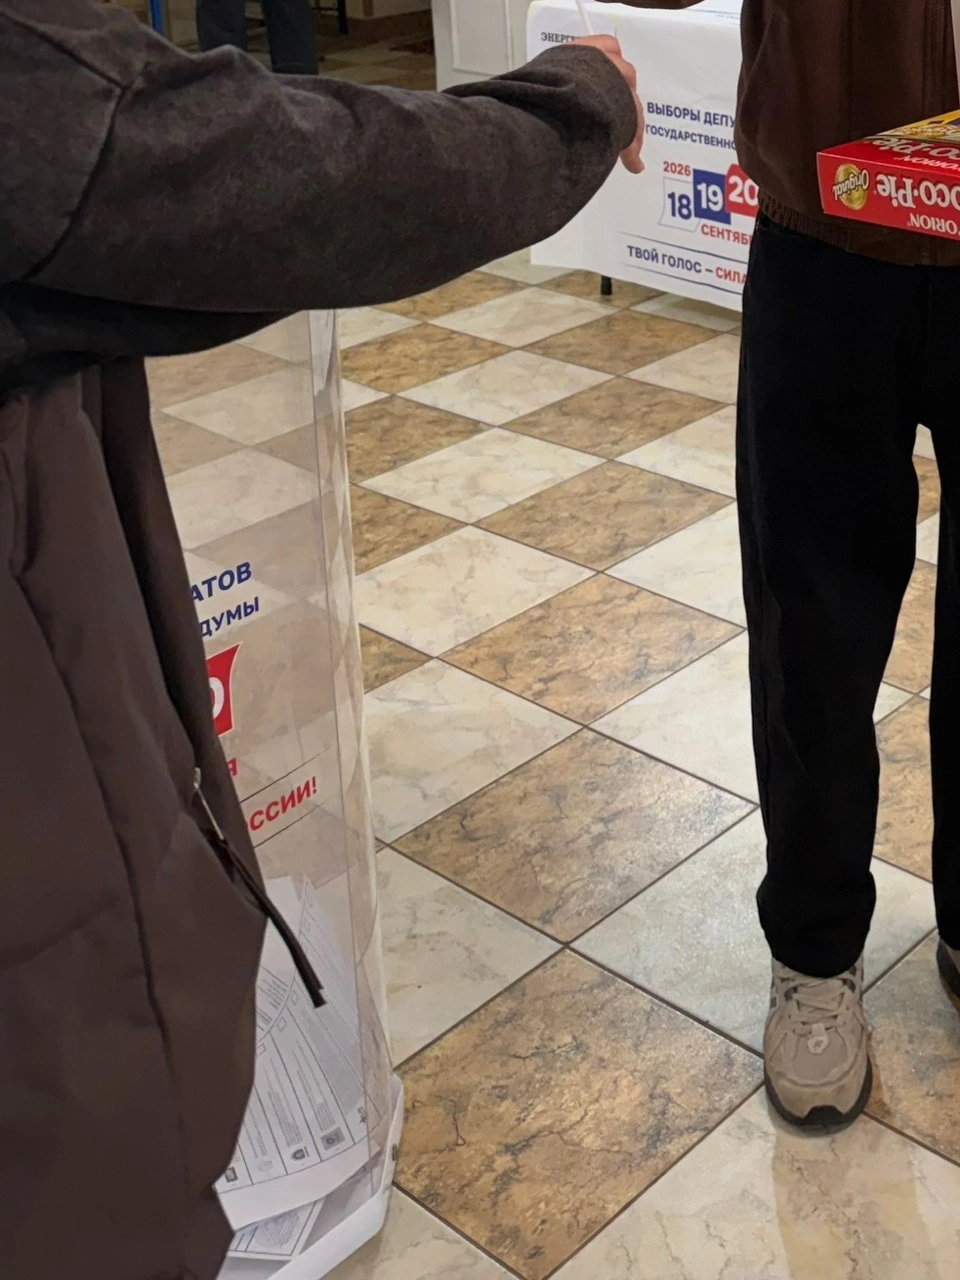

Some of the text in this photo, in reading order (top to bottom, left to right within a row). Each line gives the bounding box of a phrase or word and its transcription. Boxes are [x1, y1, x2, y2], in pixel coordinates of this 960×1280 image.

[541, 32, 576, 43] ЭНЕРГЕ
[647, 102, 735, 128] ВЫБОРЫ ДЕПУ
[646, 124, 737, 150] ГОСУДАРСТВЕННО
[663, 161, 691, 176] 2026
[668, 176, 758, 220] 18 19 20
[832, 169, 869, 201] Original
[701, 224, 752, 245] СЕНТЯБ
[910, 213, 957, 235] ORION
[627, 245, 659, 263] ТВОЙ
[662, 254, 702, 273] ГОЛОС
[191, 561, 252, 602] АТОВ
[200, 595, 259, 637] ДУМЫ
[249, 776, 317, 832] ССИИ!
